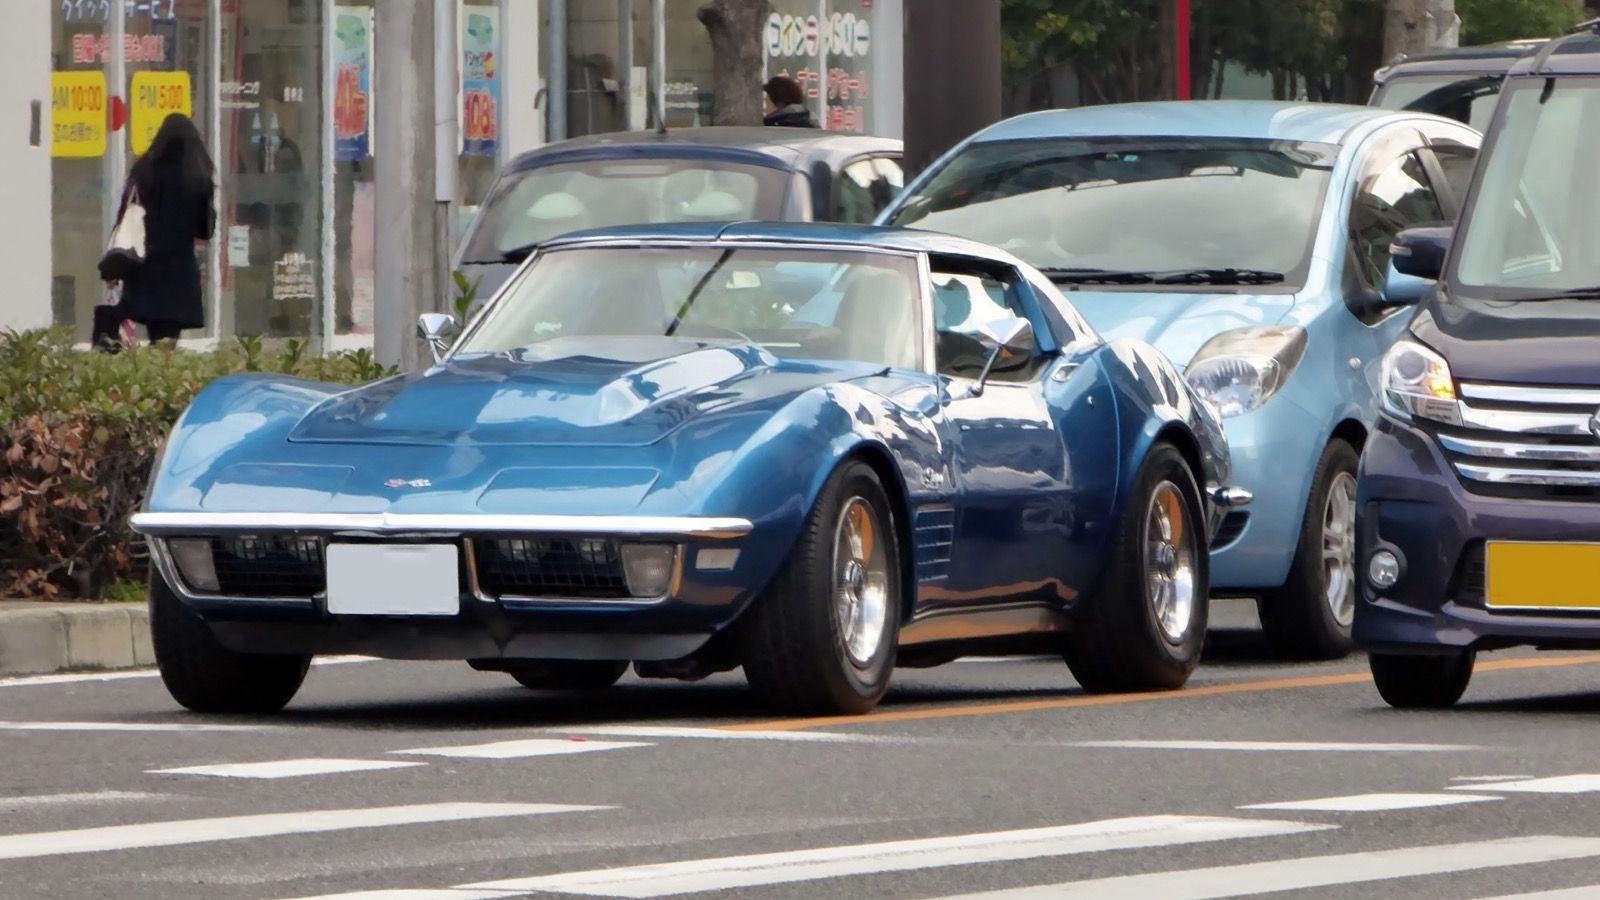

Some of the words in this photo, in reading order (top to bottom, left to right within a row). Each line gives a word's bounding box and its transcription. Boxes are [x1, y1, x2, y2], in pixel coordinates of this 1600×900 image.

[768, 13, 870, 57] コインラドリー
[71, 85, 102, 111] 10:00
